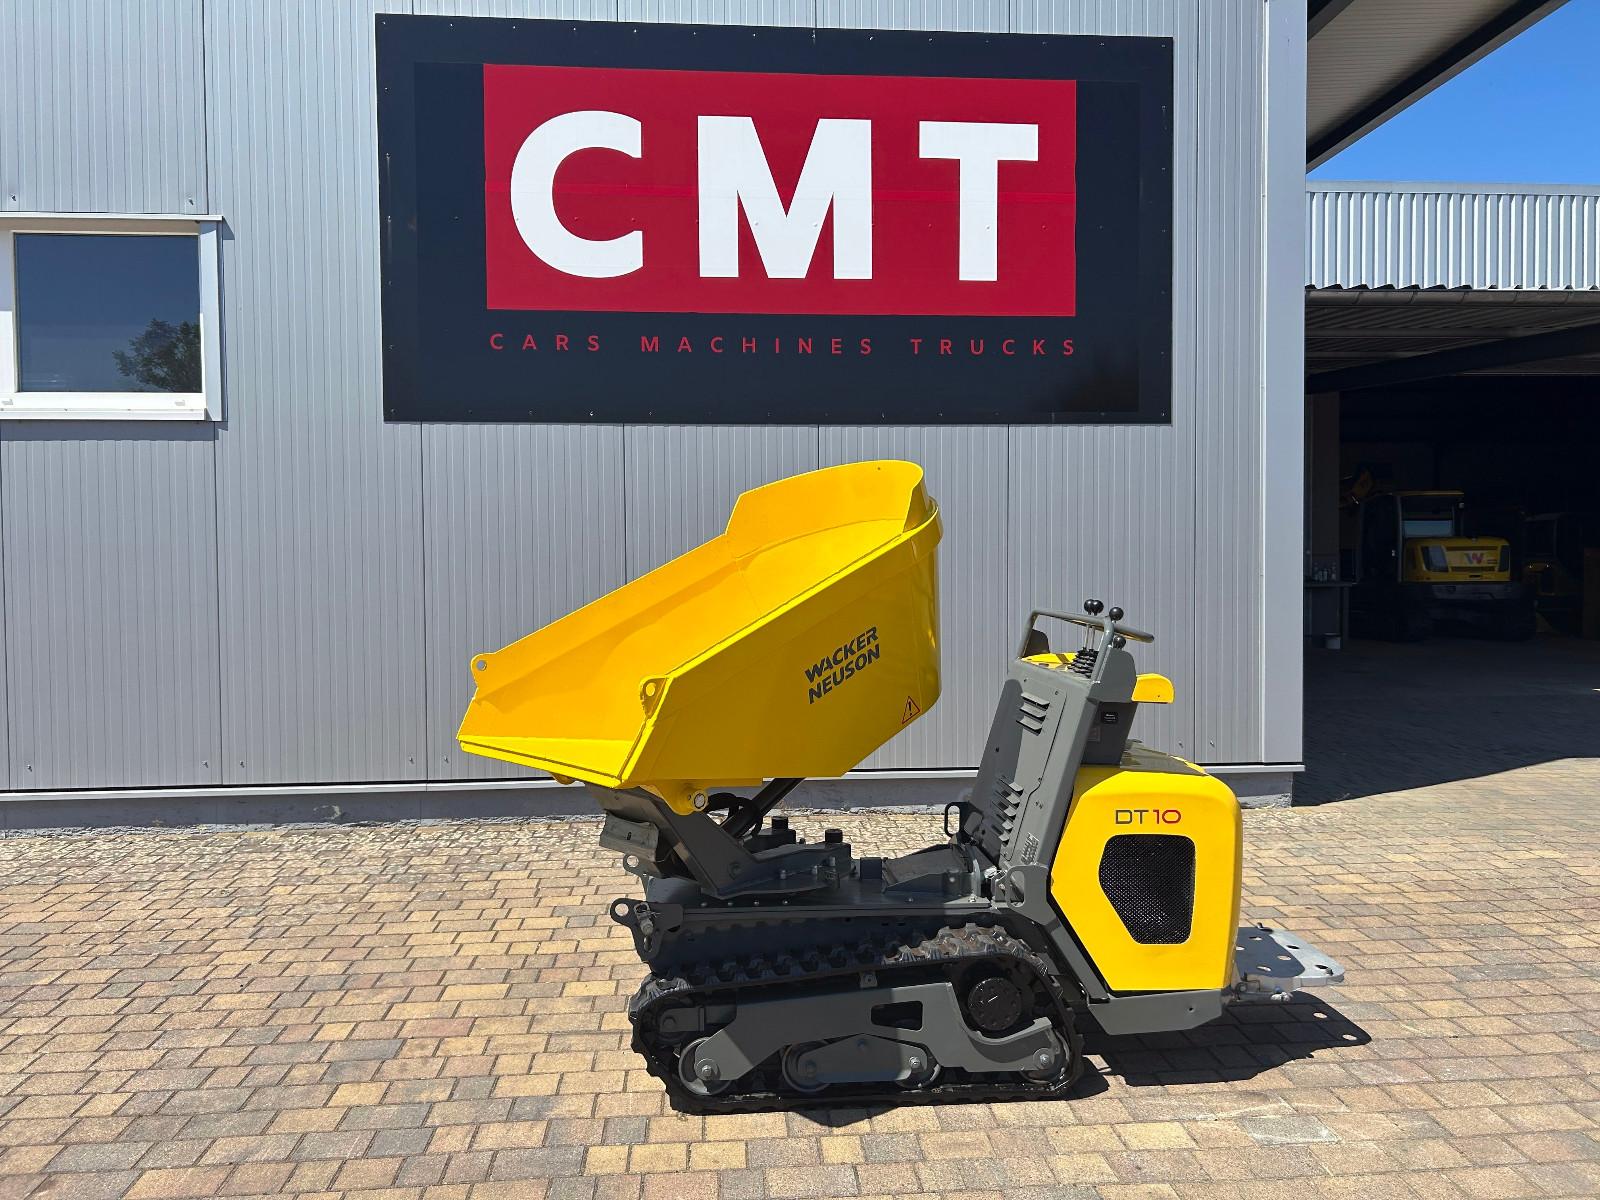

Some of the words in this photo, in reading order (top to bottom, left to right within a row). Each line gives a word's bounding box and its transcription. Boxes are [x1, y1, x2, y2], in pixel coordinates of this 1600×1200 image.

[510, 110, 1039, 281] CMT
[489, 333, 600, 352] CARS
[640, 336, 872, 355] MACHINES
[911, 338, 1074, 356] TRUCKS
[804, 626, 879, 683] WACKER
[808, 643, 880, 704] NEUSON
[1115, 809, 1182, 825] DT10
